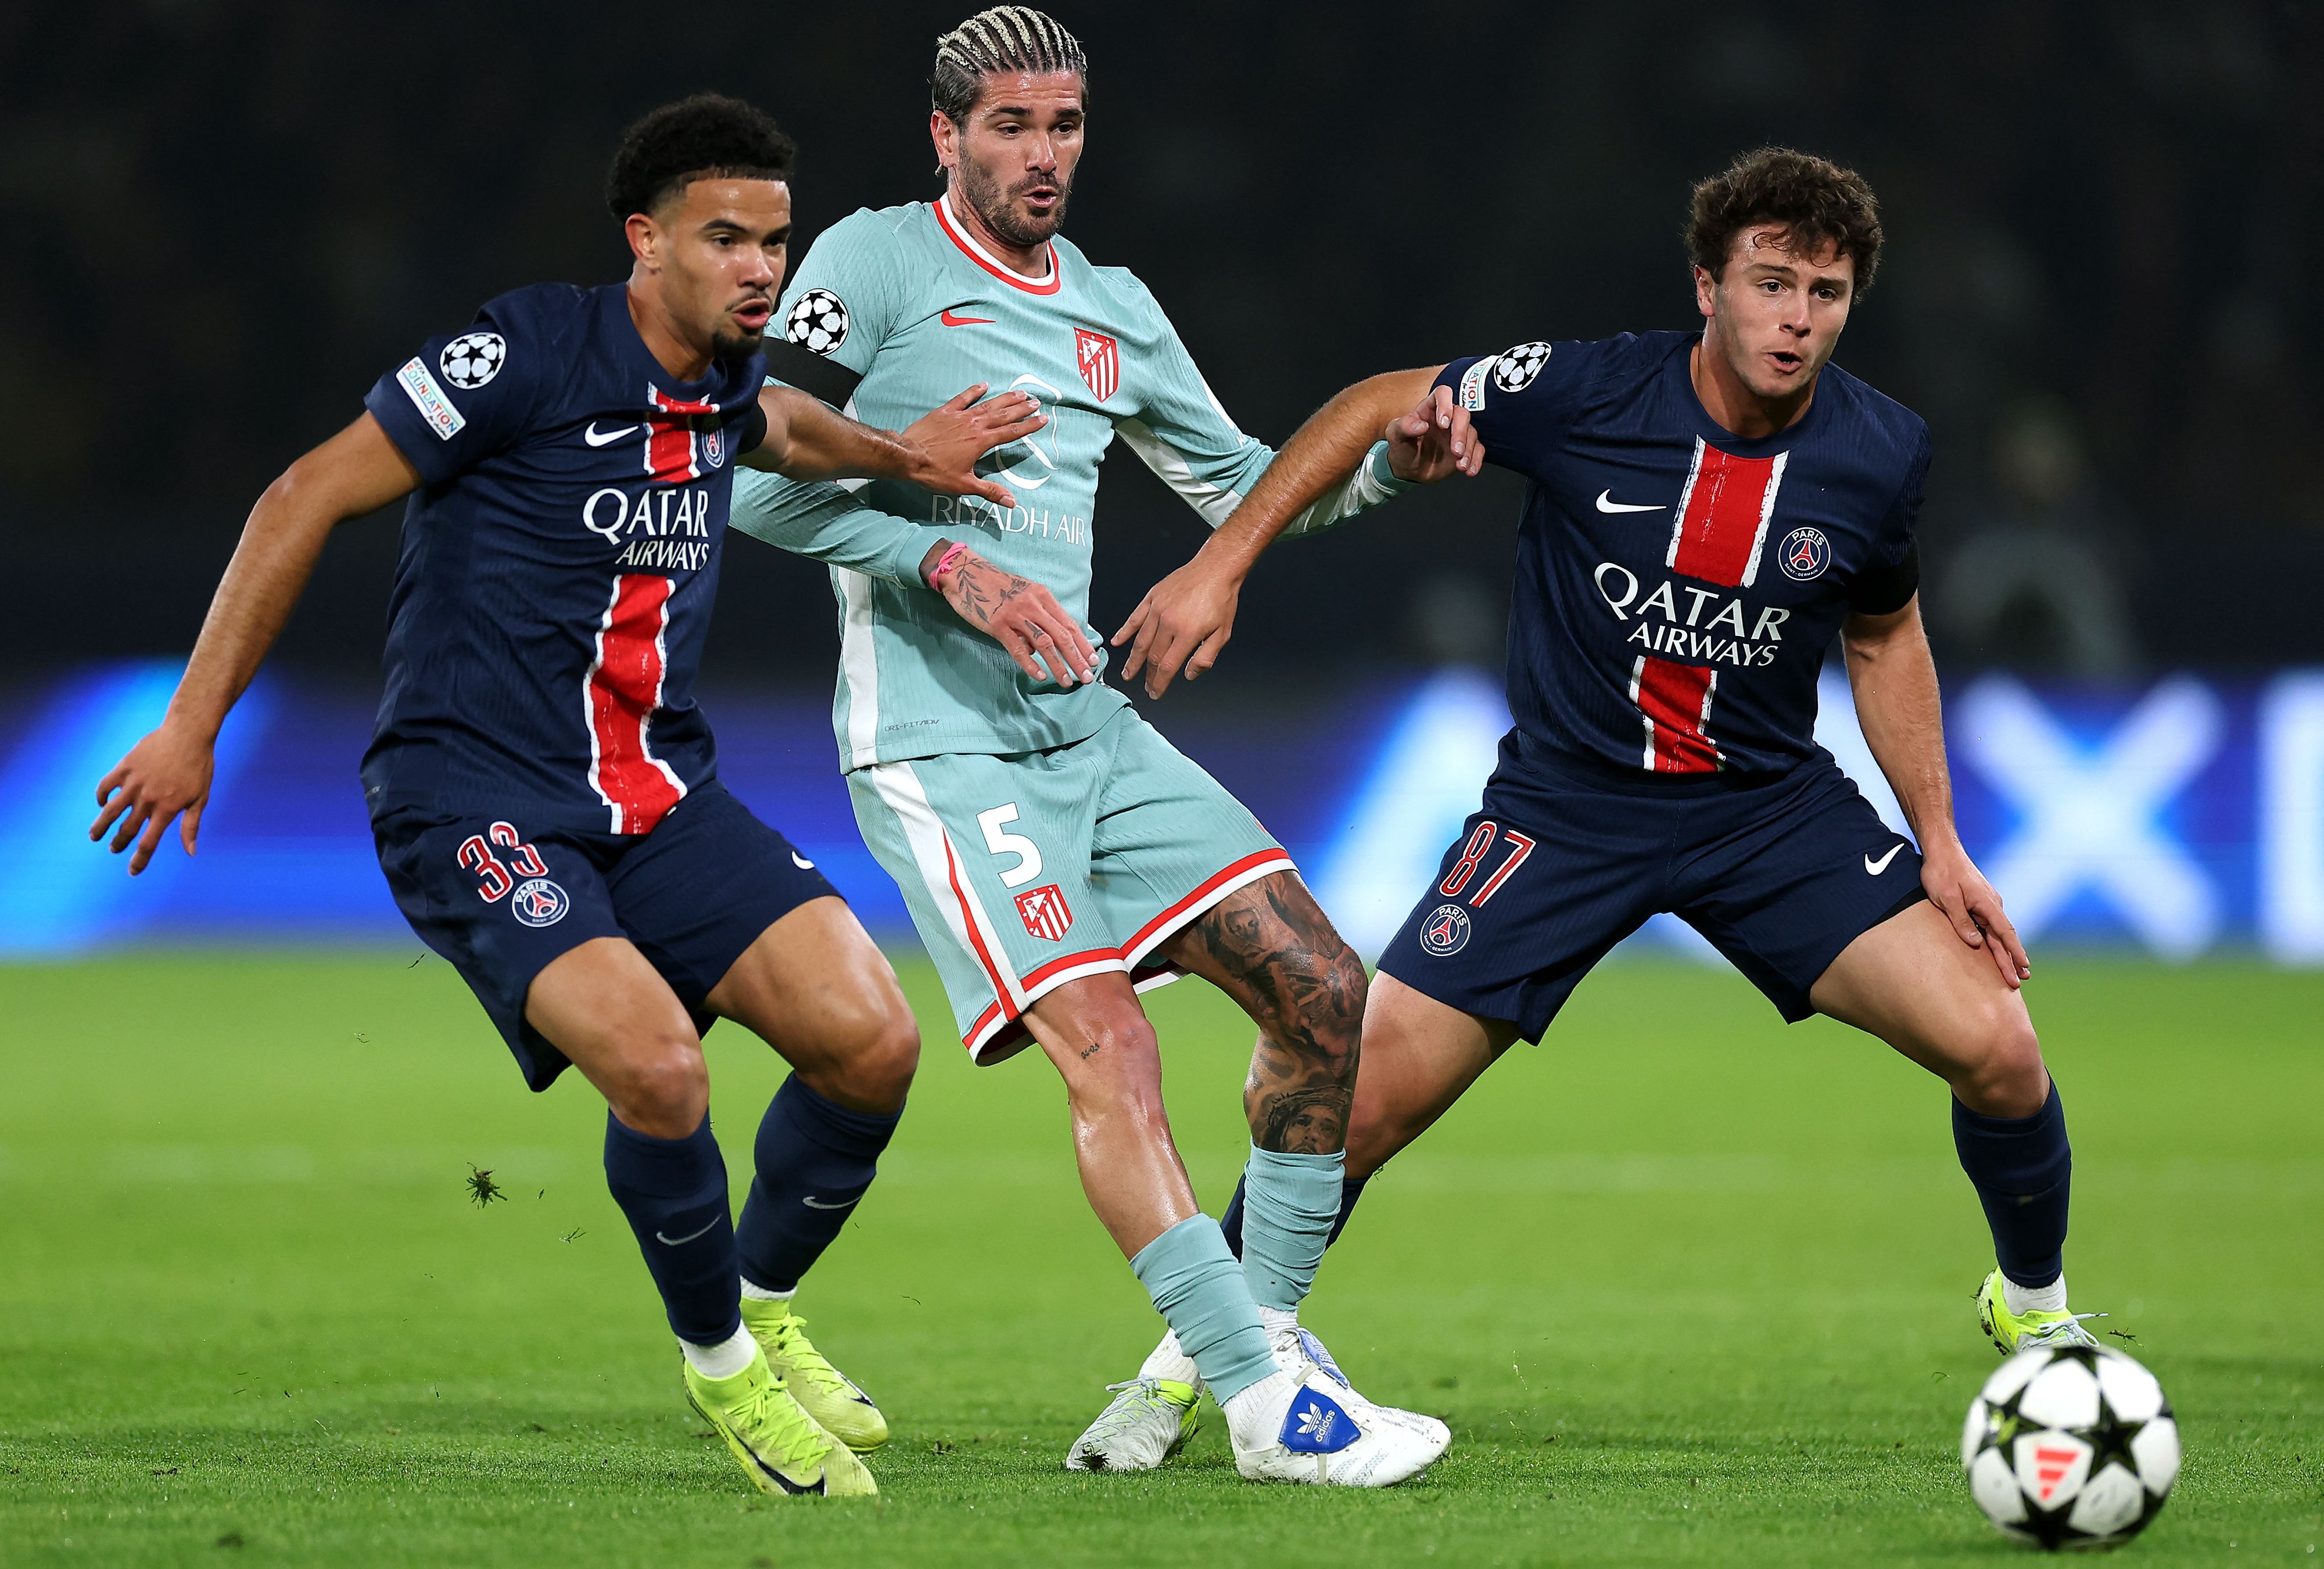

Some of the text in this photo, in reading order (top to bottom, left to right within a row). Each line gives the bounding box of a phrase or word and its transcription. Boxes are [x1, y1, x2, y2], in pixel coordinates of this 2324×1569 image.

[404, 364, 457, 433] FOUNDATION
[582, 487, 709, 546] QATAR
[931, 494, 1086, 548] RIYADH AIR
[1792, 529, 1825, 546] PARIS
[614, 540, 710, 571] AIRWAYS
[1594, 562, 1790, 641] QATAR
[1627, 622, 1778, 667] AIRWAYS
[457, 820, 550, 904] 33
[975, 801, 1043, 889] 5
[1439, 820, 1537, 909] 87
[515, 881, 548, 903] PARIS
[1439, 907, 1467, 926] PARIS
[1315, 1410, 1336, 1443] adidas
